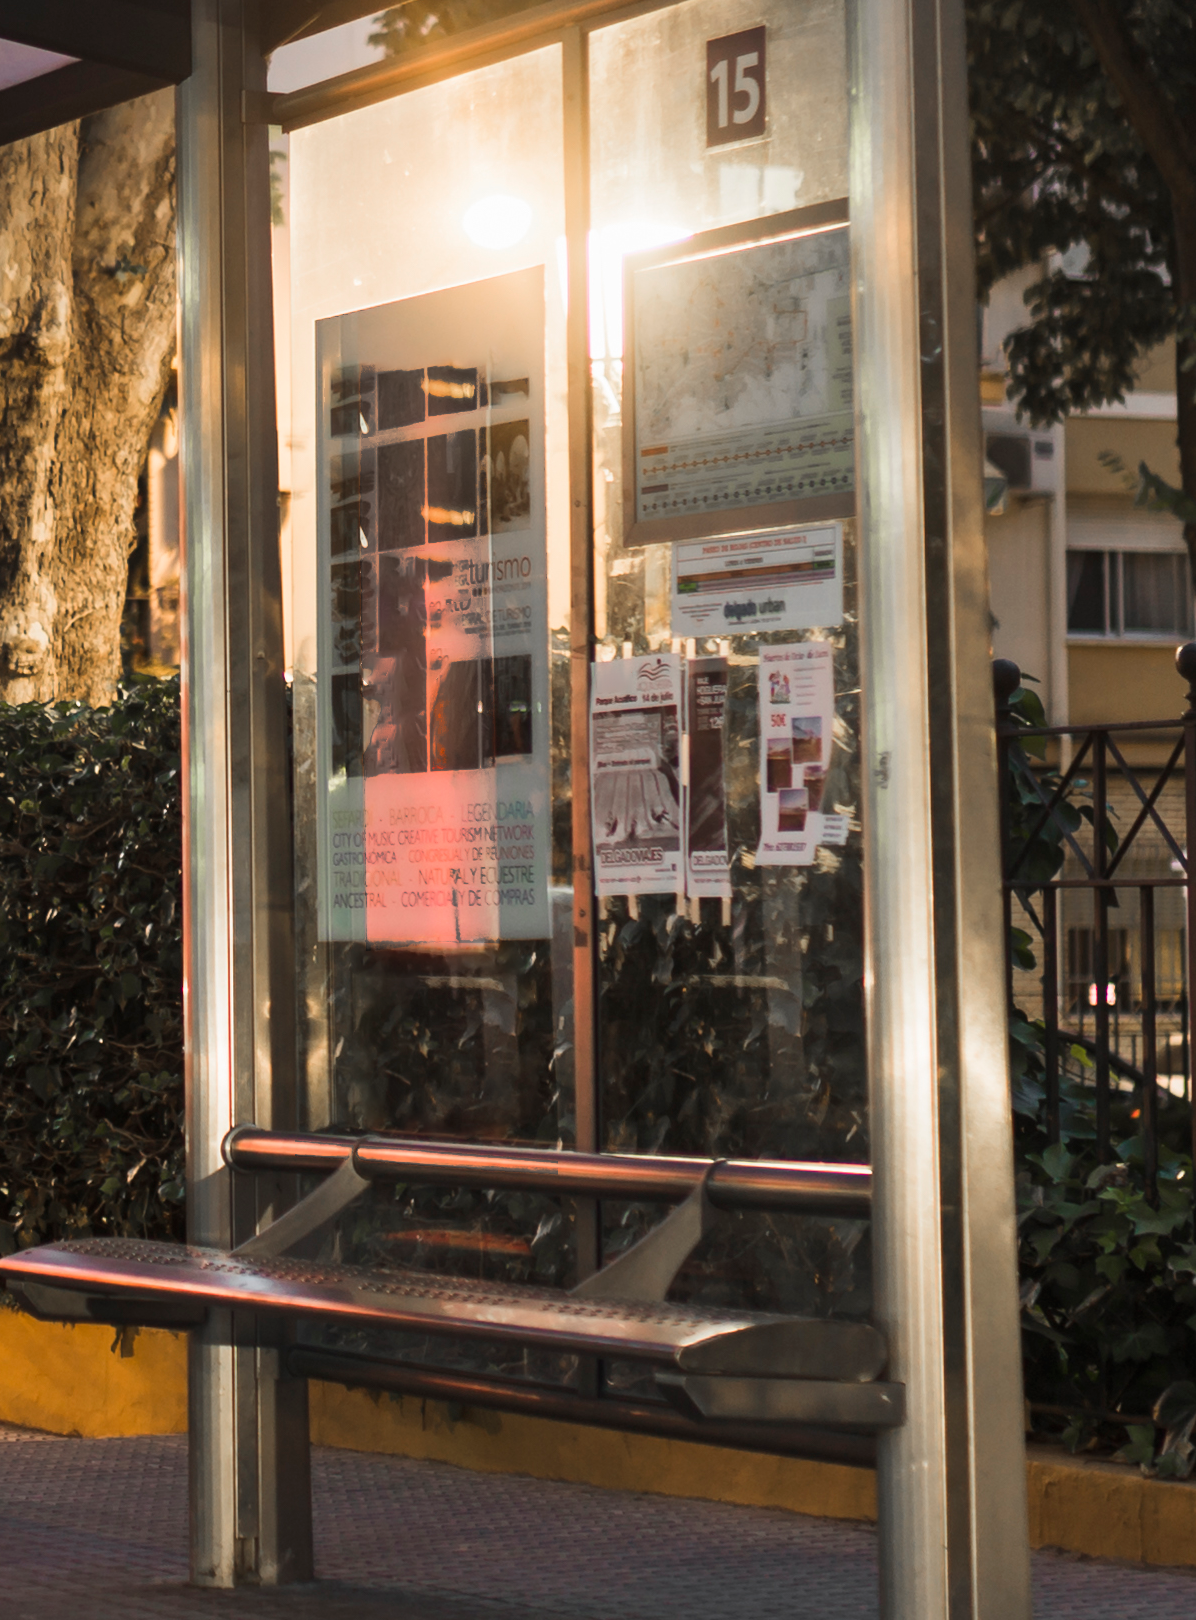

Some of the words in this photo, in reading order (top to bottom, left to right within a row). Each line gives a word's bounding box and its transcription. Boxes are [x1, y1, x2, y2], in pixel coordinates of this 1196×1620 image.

[710, 51, 760, 128] 15
[469, 552, 532, 584] turismo
[389, 806, 444, 826] BARROCA
[333, 833, 351, 849] CITY
[368, 831, 395, 847] MUSIC
[397, 829, 439, 846] CREATIVE
[442, 826, 482, 843] TOURISM
[484, 824, 535, 842] NETWORK
[408, 848, 463, 863] CONGRESUAL
[472, 846, 483, 861] DE
[485, 845, 535, 861] REUNIONES
[418, 867, 469, 885] NATURAL
[470, 867, 477, 884] Y
[480, 865, 535, 885] ECUESTRE
[333, 892, 387, 909] ANCESTRAL
[469, 889, 481, 906] DE
[485, 888, 535, 907] COMPRAS
